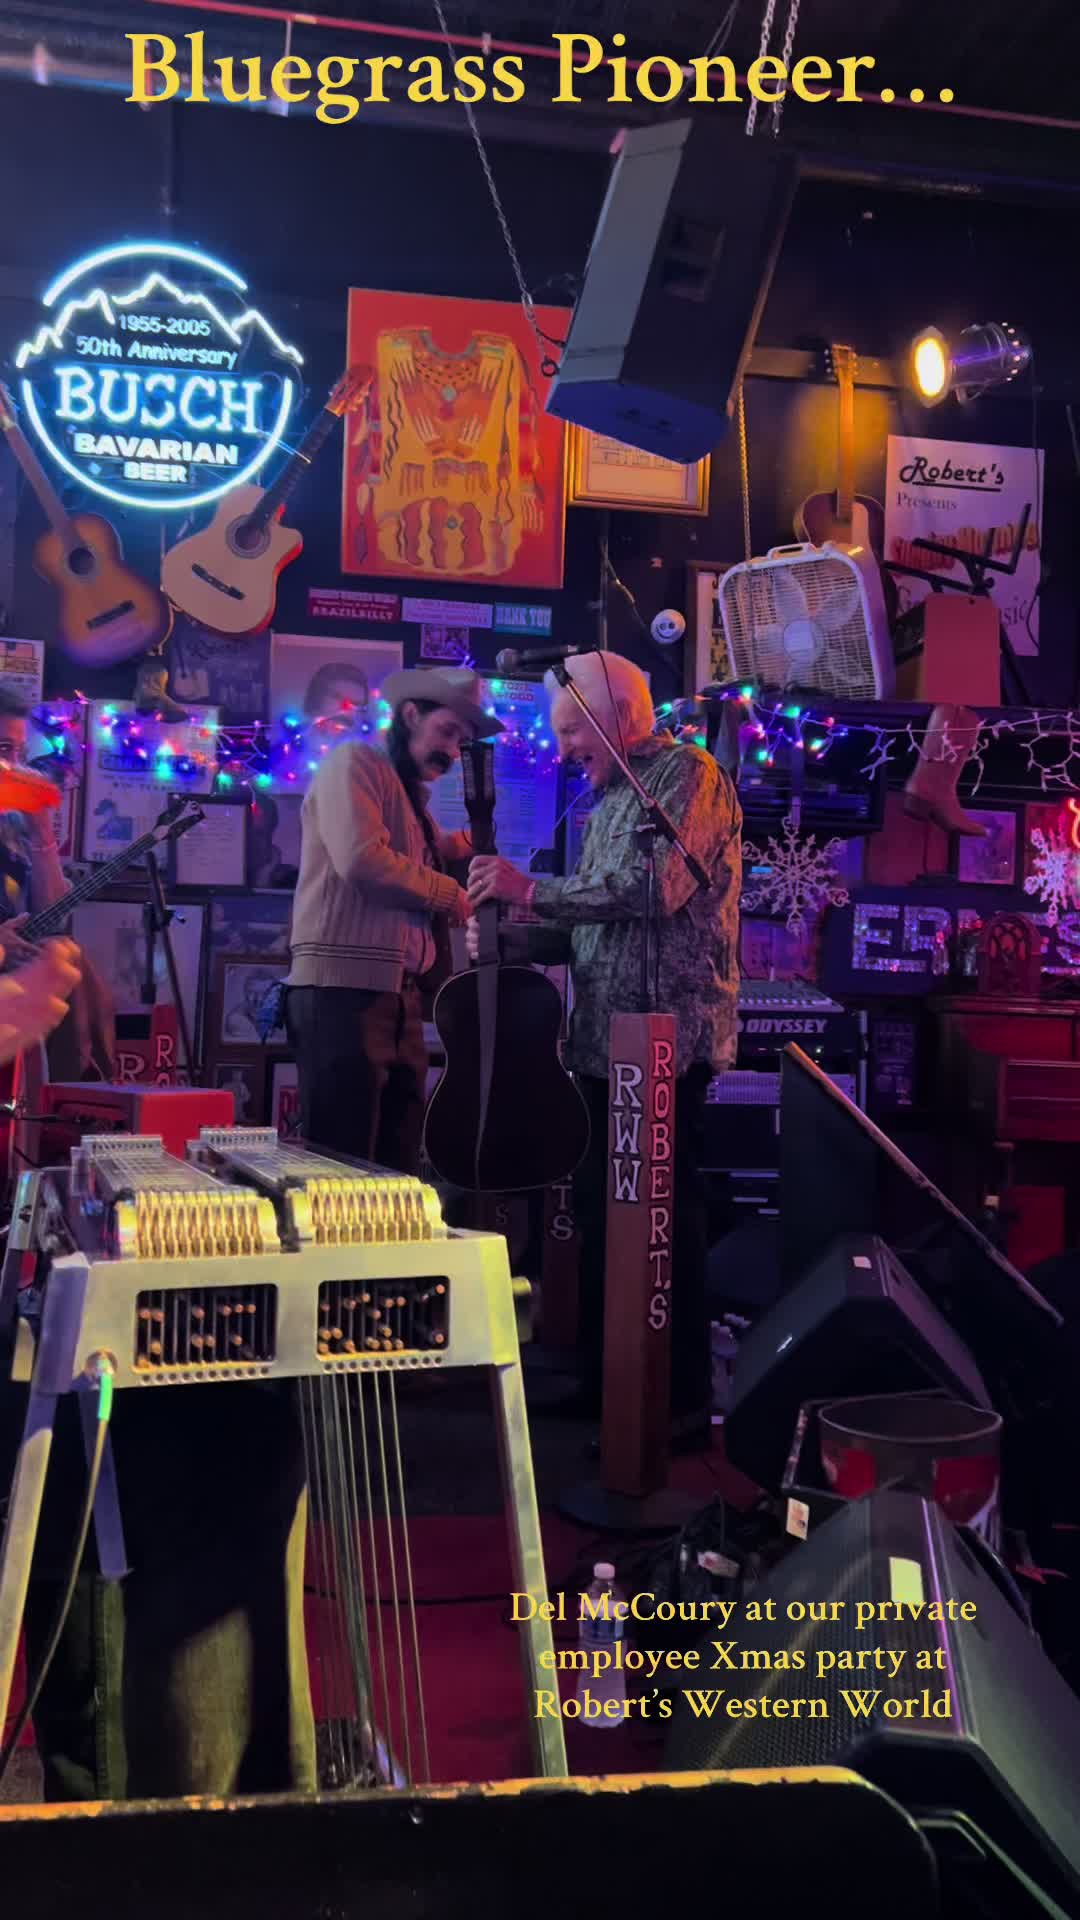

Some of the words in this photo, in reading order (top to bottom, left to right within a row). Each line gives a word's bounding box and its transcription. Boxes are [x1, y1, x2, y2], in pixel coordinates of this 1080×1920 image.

[119, 313, 212, 337] 1955-2005
[76, 336, 123, 358] 50th
[127, 341, 238, 371] Anniversary
[53, 365, 264, 434] BUSCH
[73, 432, 239, 465] BAVARIAN
[123, 461, 188, 484] BEER
[899, 456, 1004, 485] Robert's
[528, 608, 551, 628] YOU
[746, 1019, 827, 1033] ODYSSEY
[612, 1062, 642, 1202] RWW
